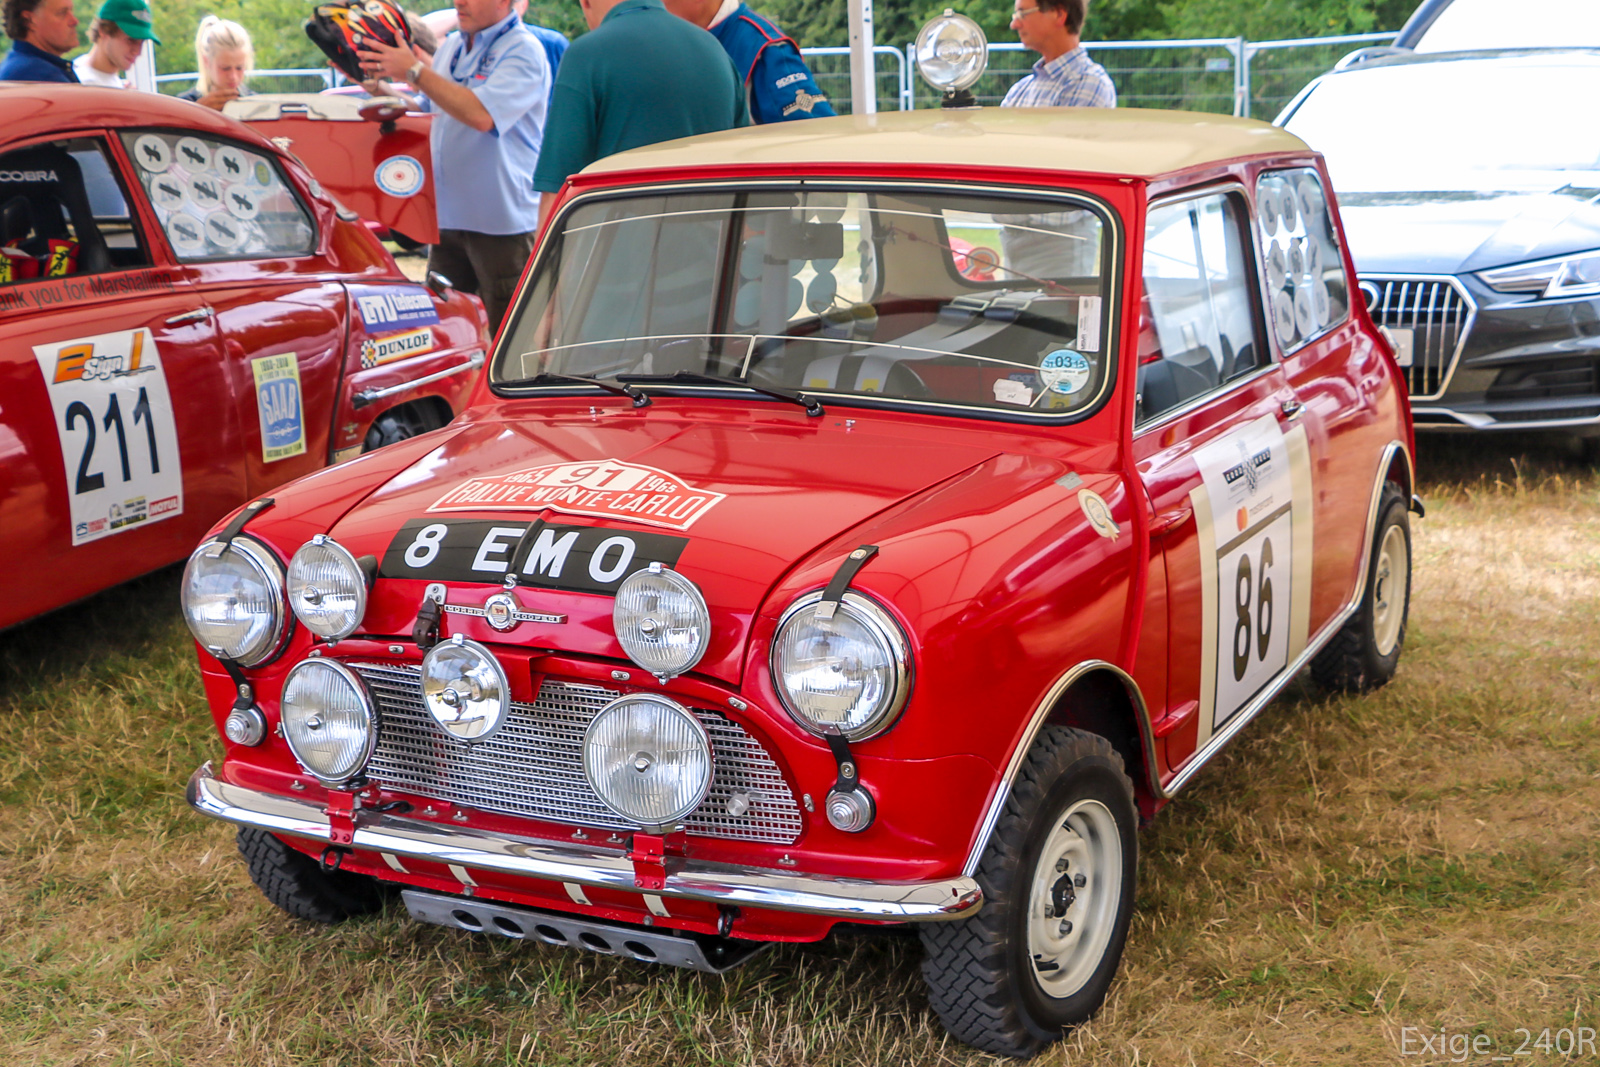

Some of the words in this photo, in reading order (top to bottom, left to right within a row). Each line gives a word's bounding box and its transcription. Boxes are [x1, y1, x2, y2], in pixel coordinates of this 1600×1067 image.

[0, 170, 59, 182] COBRA
[30, 286, 63, 309] you
[63, 280, 86, 300] for
[88, 270, 174, 297] Marshalling
[378, 333, 430, 357] DUNLOP
[1055, 356, 1072, 368] 03
[1074, 360, 1086, 368] 15
[261, 382, 296, 426] SAAB
[65, 386, 160, 495] 211
[503, 467, 553, 483] 1965
[560, 466, 626, 488] 91
[634, 474, 678, 493] 1965
[150, 497, 178, 515] MOTUL
[449, 481, 526, 504] RALLYE
[531, 486, 707, 520] MONTE-CARLO
[404, 523, 449, 568] 8
[471, 526, 637, 583] EMO
[502, 573, 518, 590] S
[445, 604, 485, 616] MORRIS
[512, 612, 559, 623] COOPER
[1233, 536, 1274, 682] 86
